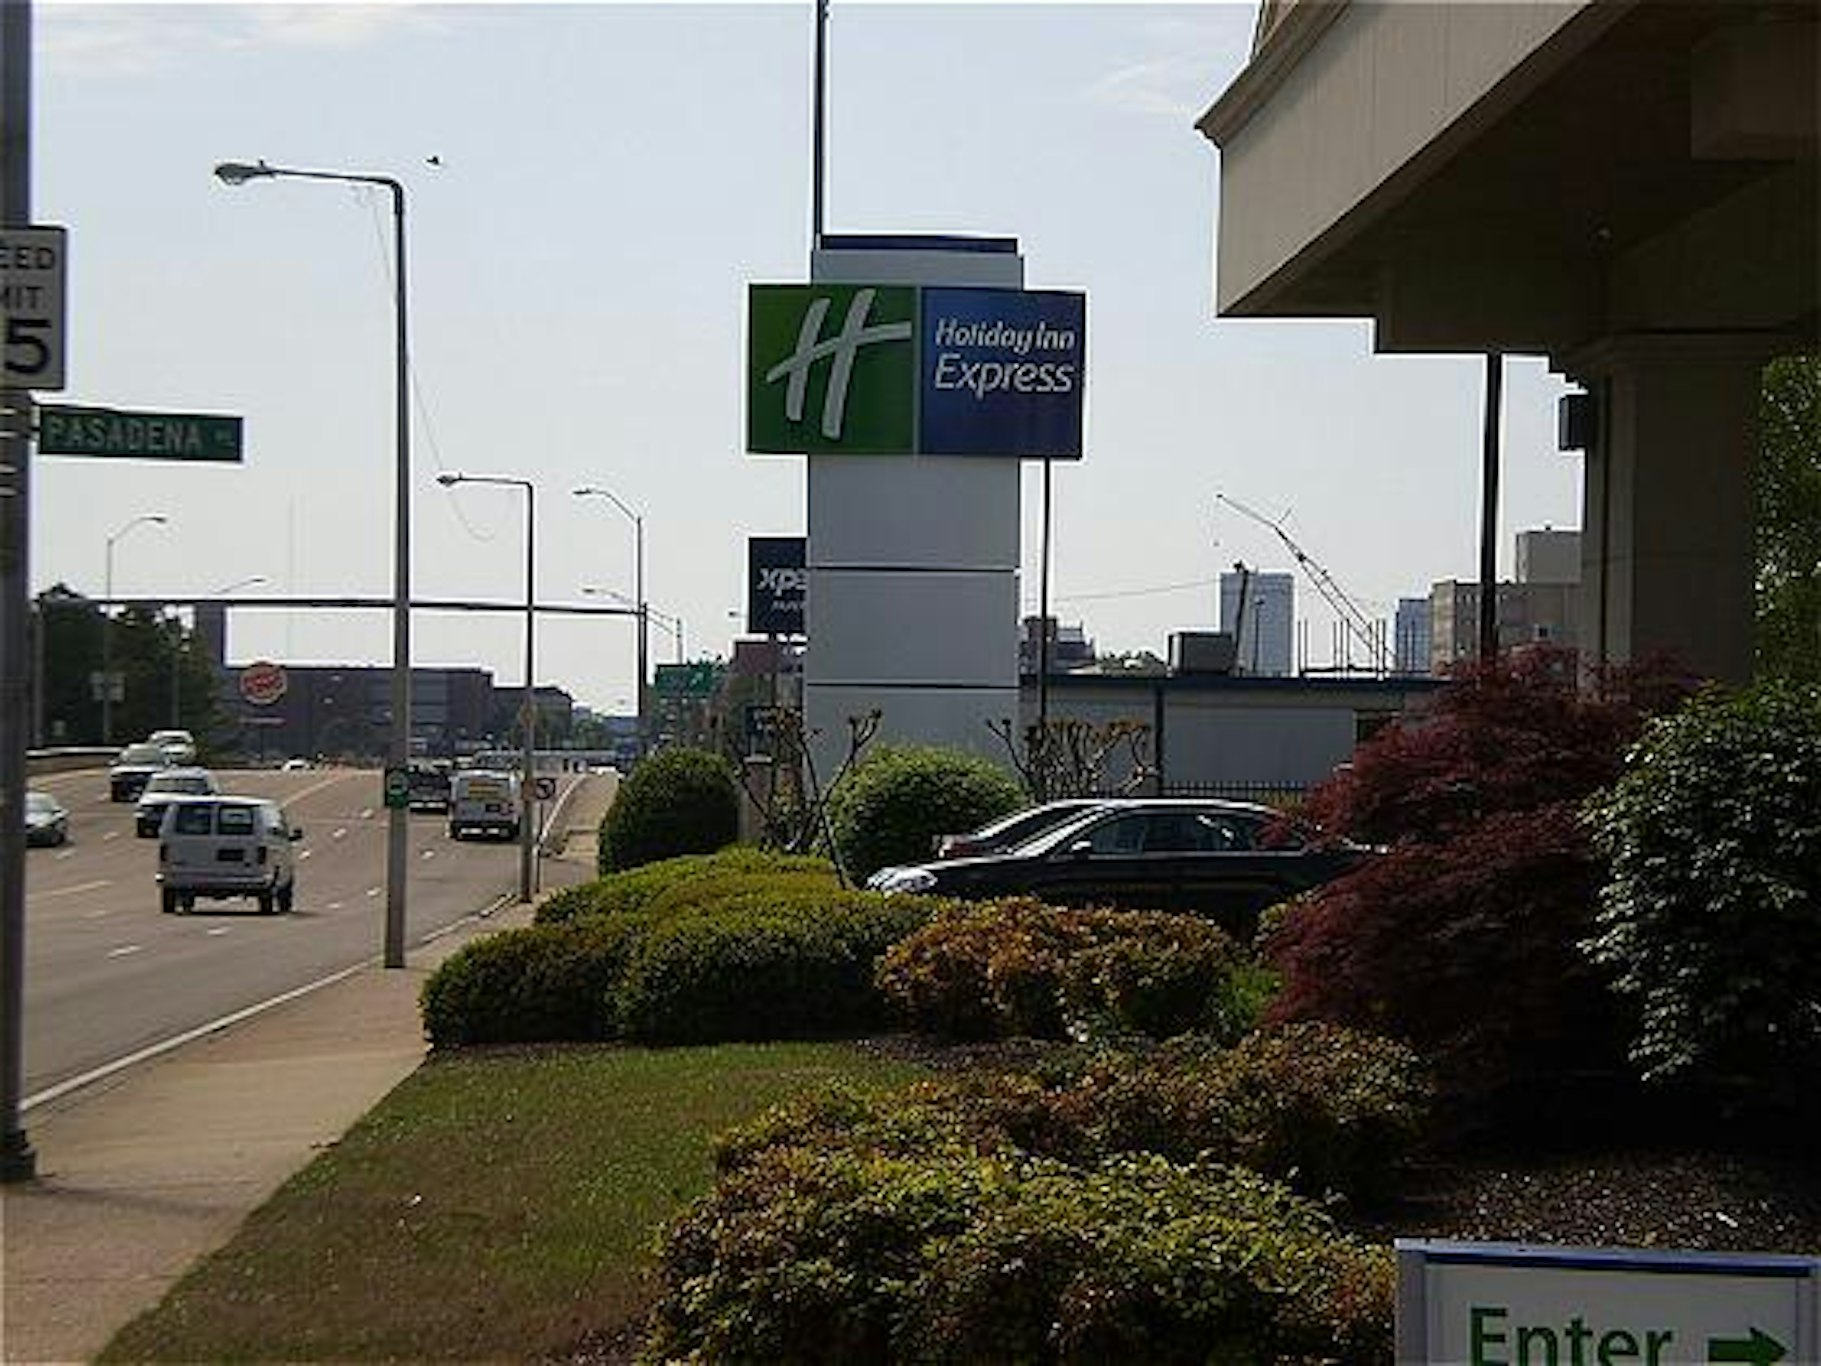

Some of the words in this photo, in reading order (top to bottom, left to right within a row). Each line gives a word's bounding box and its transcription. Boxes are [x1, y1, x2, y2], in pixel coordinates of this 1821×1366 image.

[4, 318, 50, 374] 5
[935, 317, 1031, 356] Holiday
[1036, 321, 1076, 349] Inn
[934, 353, 1076, 400] Express
[47, 414, 202, 452] PASADENA
[1470, 1307, 1673, 1366] Enter
